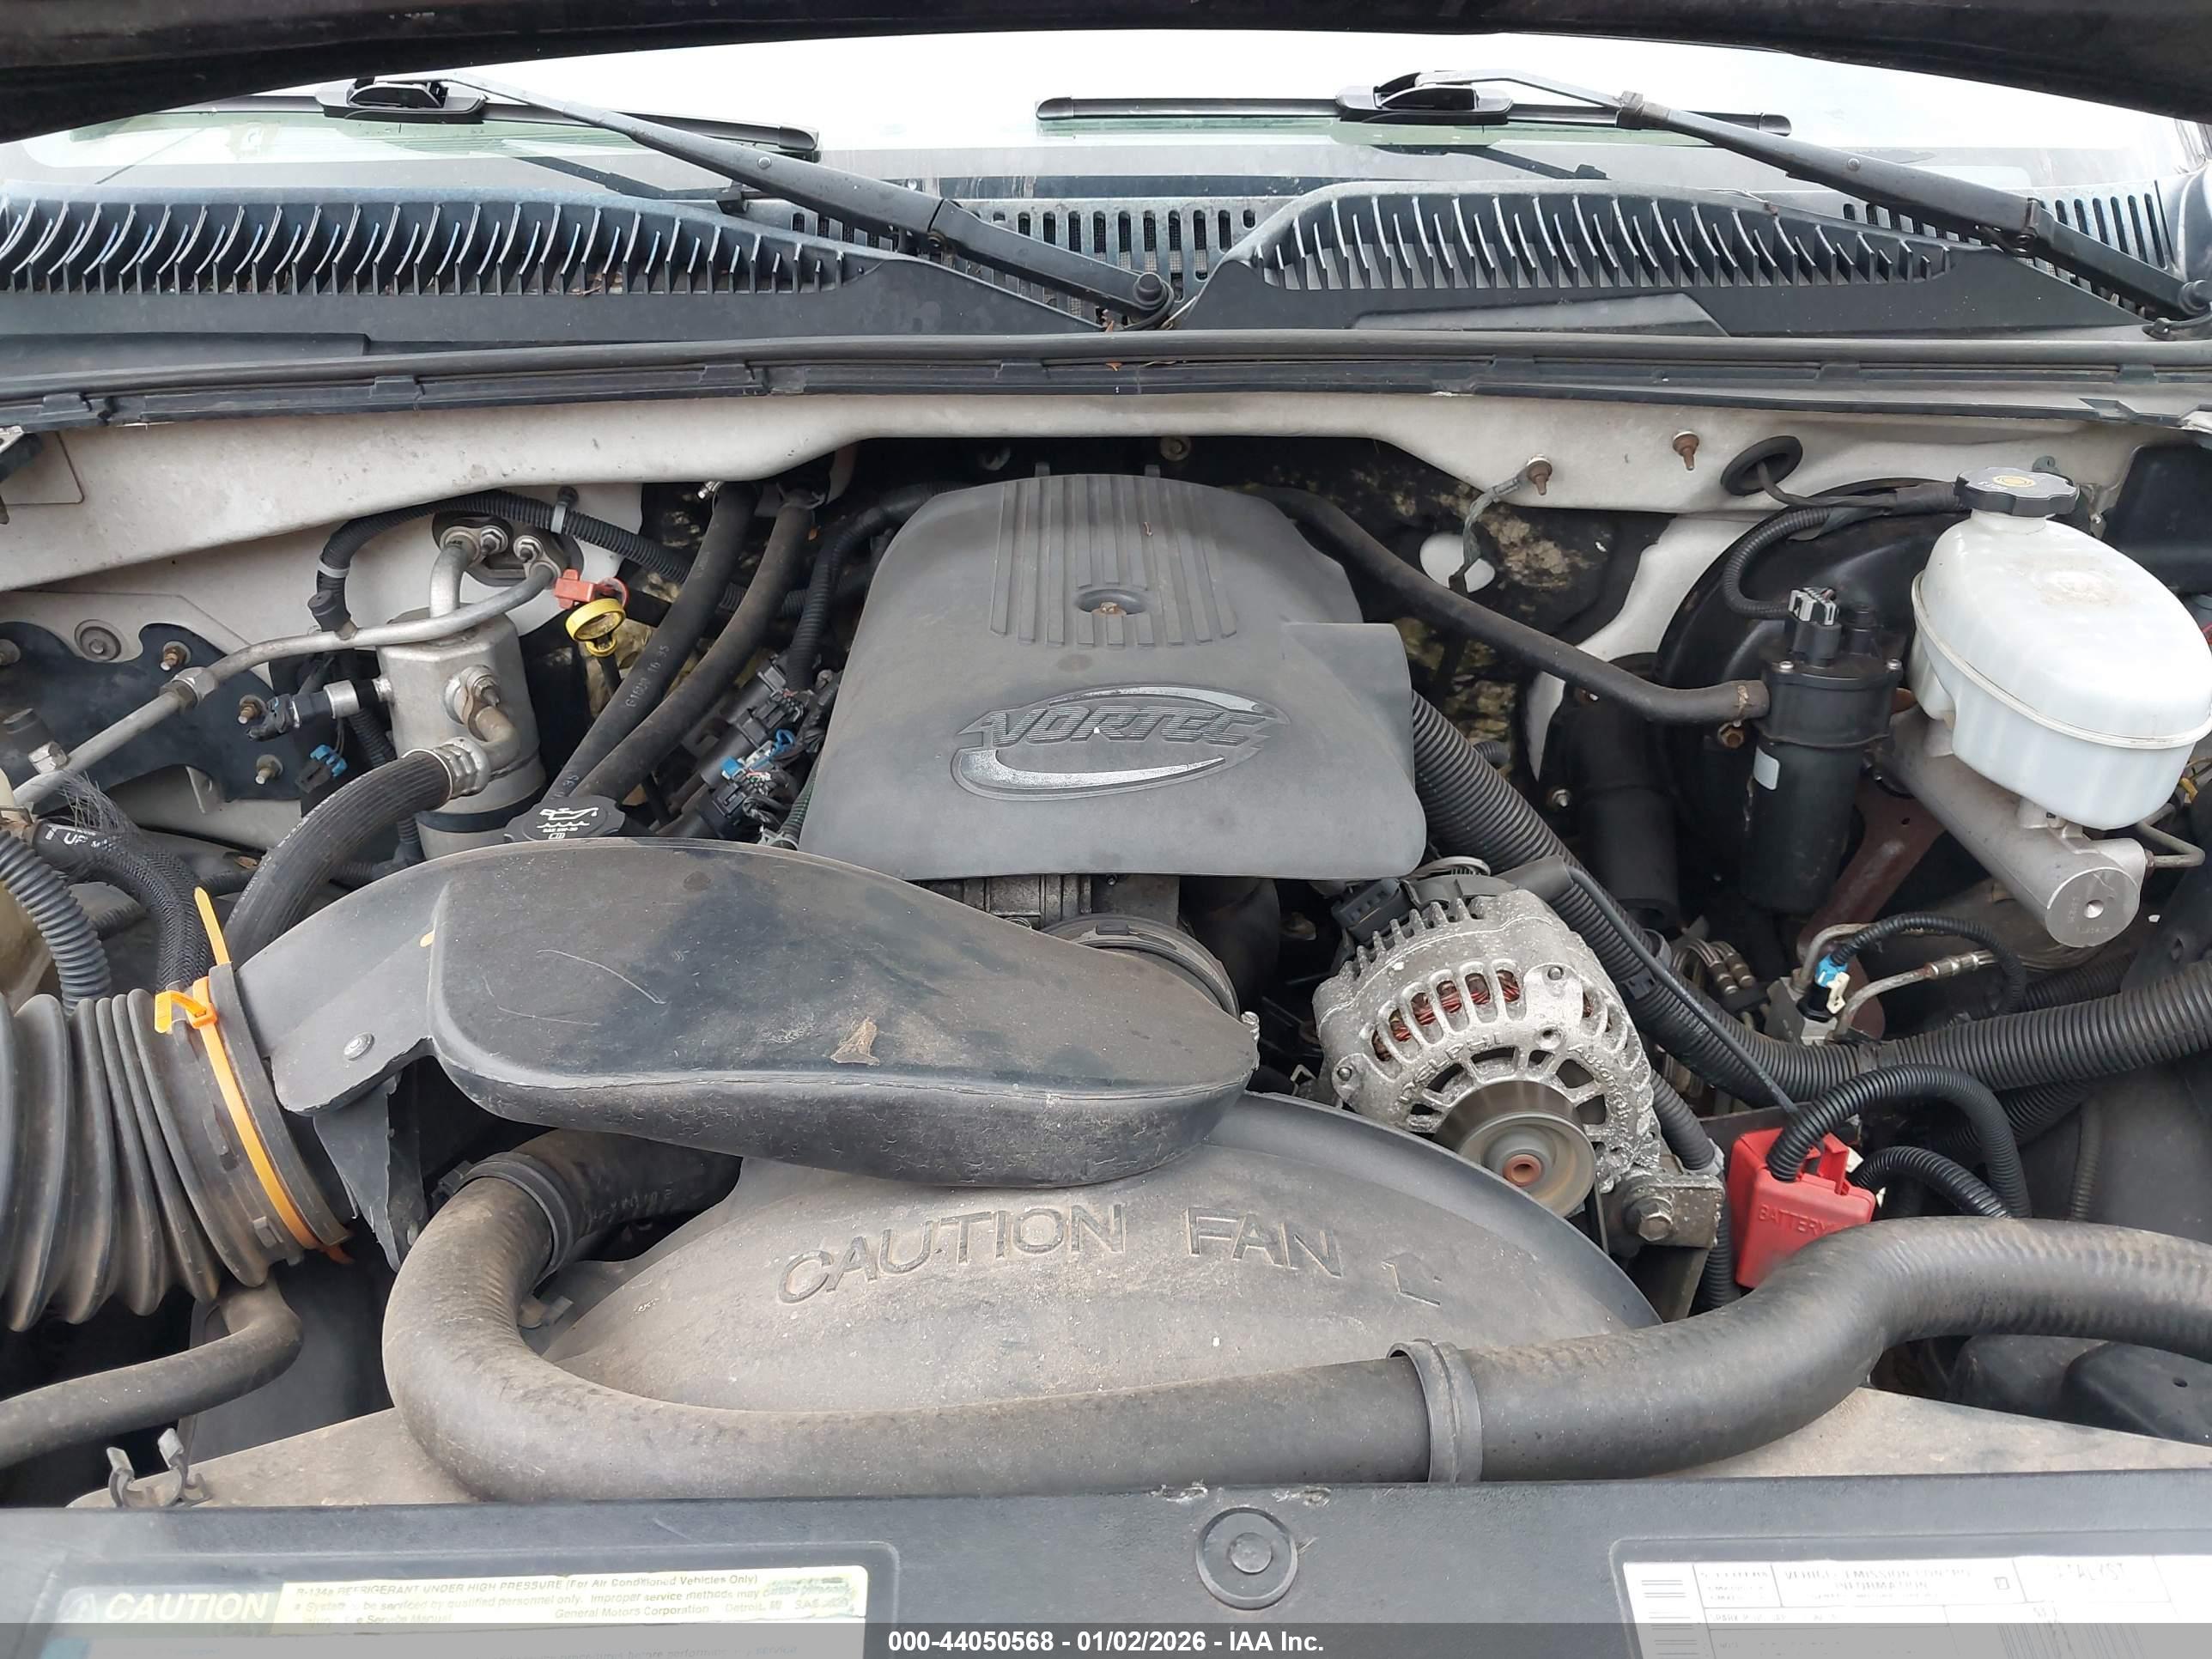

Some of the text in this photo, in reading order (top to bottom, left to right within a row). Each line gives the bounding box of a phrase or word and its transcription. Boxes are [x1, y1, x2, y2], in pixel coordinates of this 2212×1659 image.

[981, 705, 1275, 746] VORTEC
[1759, 1204, 1837, 1237] BATTERY
[777, 1203, 1342, 1304] CAUTION FAN
[337, 1584, 419, 1595] REFRIGERANT
[423, 1583, 464, 1594] UNDER
[466, 1582, 496, 1592] HIGH
[499, 1580, 562, 1591] PRESSURE
[566, 1580, 588, 1590] (For
[591, 1578, 607, 1589] Air
[611, 1577, 676, 1587] Conditioned
[680, 1575, 726, 1586] Vehicles
[729, 1574, 758, 1585] Only)
[556, 1594, 583, 1606] only.
[590, 1593, 641, 1605] Improper
[643, 1591, 683, 1602] service
[685, 1589, 733, 1601] methods
[736, 1589, 759, 1601] may
[104, 1593, 271, 1621] CAUTION
[554, 1607, 599, 1619] General
[601, 1607, 641, 1617] Motors
[643, 1605, 709, 1616] Corporation
